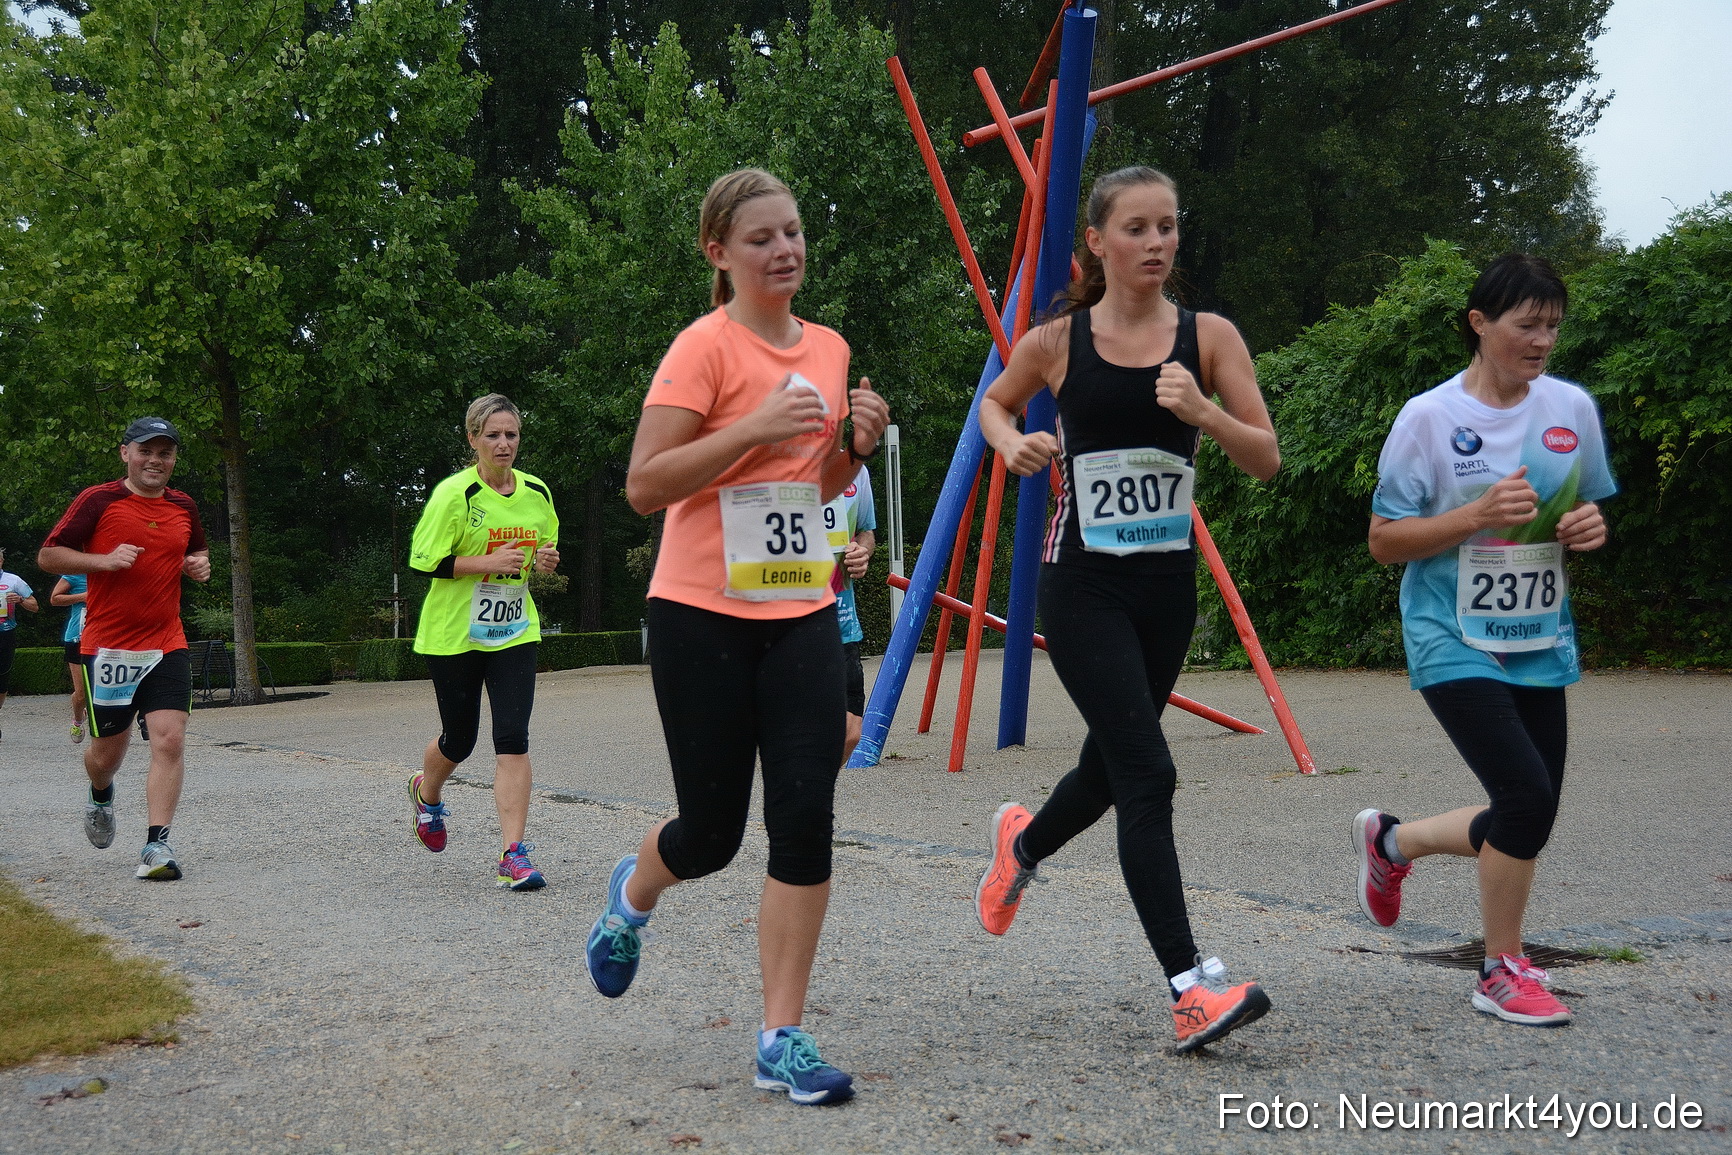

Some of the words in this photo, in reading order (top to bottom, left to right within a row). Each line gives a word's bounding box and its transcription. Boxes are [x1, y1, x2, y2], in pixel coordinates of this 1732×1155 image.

[1453, 459, 1489, 471] PARTL
[1455, 468, 1490, 478] Neumarkt
[1090, 472, 1183, 519] 2807
[488, 527, 537, 540] Müller
[765, 512, 807, 555] 35
[1116, 523, 1167, 543] Kathrin
[1512, 548, 1554, 562] BOCK
[762, 567, 812, 584] Leonie
[1470, 569, 1556, 611] 2378
[477, 597, 523, 622] 2068
[1485, 621, 1541, 639] Krystyna
